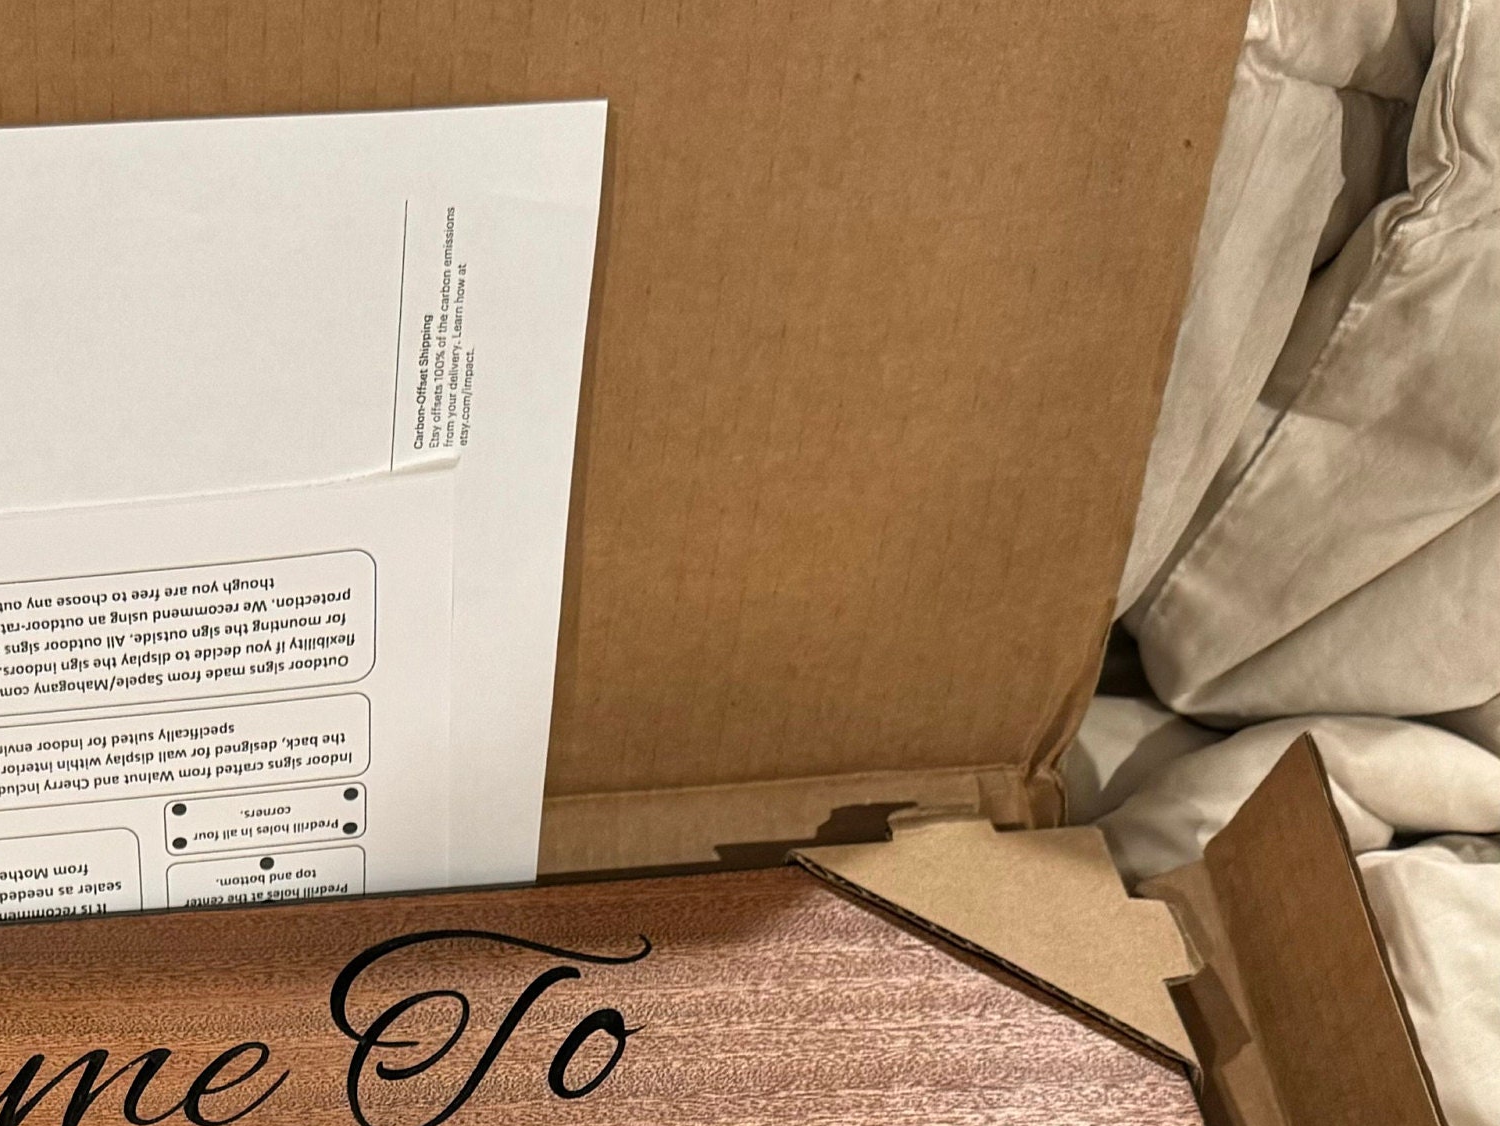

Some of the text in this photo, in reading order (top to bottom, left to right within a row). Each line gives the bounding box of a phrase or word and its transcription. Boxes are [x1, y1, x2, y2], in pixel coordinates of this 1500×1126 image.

[429, 206, 455, 449] Etsy offsets 100% of the carbon emissions
[443, 263, 467, 447] from your delivery. Learn how at
[414, 314, 434, 450] Carbon-Offset Shipping
[164, 586, 187, 597] are
[192, 580, 219, 595] you
[223, 577, 274, 595] though
[26, 595, 52, 610] any
[56, 593, 107, 607] choose
[112, 591, 127, 603] to
[131, 588, 160, 602] free
[252, 615, 321, 634] mounting
[325, 613, 346, 627] for
[130, 629, 188, 647] outside.
[192, 624, 220, 640] sign
[225, 623, 249, 638] the
[4, 640, 40, 655] signs
[44, 636, 102, 653] outdoor
[107, 634, 125, 649] All
[246, 638, 272, 654] you
[275, 640, 285, 655] if
[289, 632, 355, 651] flexibility
[121, 650, 171, 668] display
[175, 649, 190, 662] to
[194, 645, 241, 662] decide
[0, 661, 57, 677] indoors.
[61, 657, 89, 672] sign
[93, 656, 117, 672] the
[250, 660, 285, 675] signs
[288, 655, 349, 671] Outdoor
[167, 670, 201, 684] from
[205, 665, 245, 681] made
[34, 672, 164, 694] Sapele/Mahogany
[111, 732, 154, 748] suited
[158, 722, 234, 743] specifically
[36, 737, 83, 753] indoor
[87, 736, 107, 750] for
[268, 756, 302, 771] signs
[306, 752, 352, 768] Indoor
[124, 770, 175, 785] Walnut
[179, 766, 212, 780] from
[216, 761, 264, 779] crafted
[44, 777, 89, 791] Cherry
[94, 775, 119, 789] and
[240, 805, 291, 819] corners.
[193, 821, 339, 842] Predrill holes in all four
[53, 864, 88, 876] from
[216, 867, 316, 887] top and bottom.
[0, 887, 53, 905] needed
[58, 885, 73, 896] as
[77, 881, 121, 895] sealer
[186, 883, 349, 908] Predrill holes at the center
